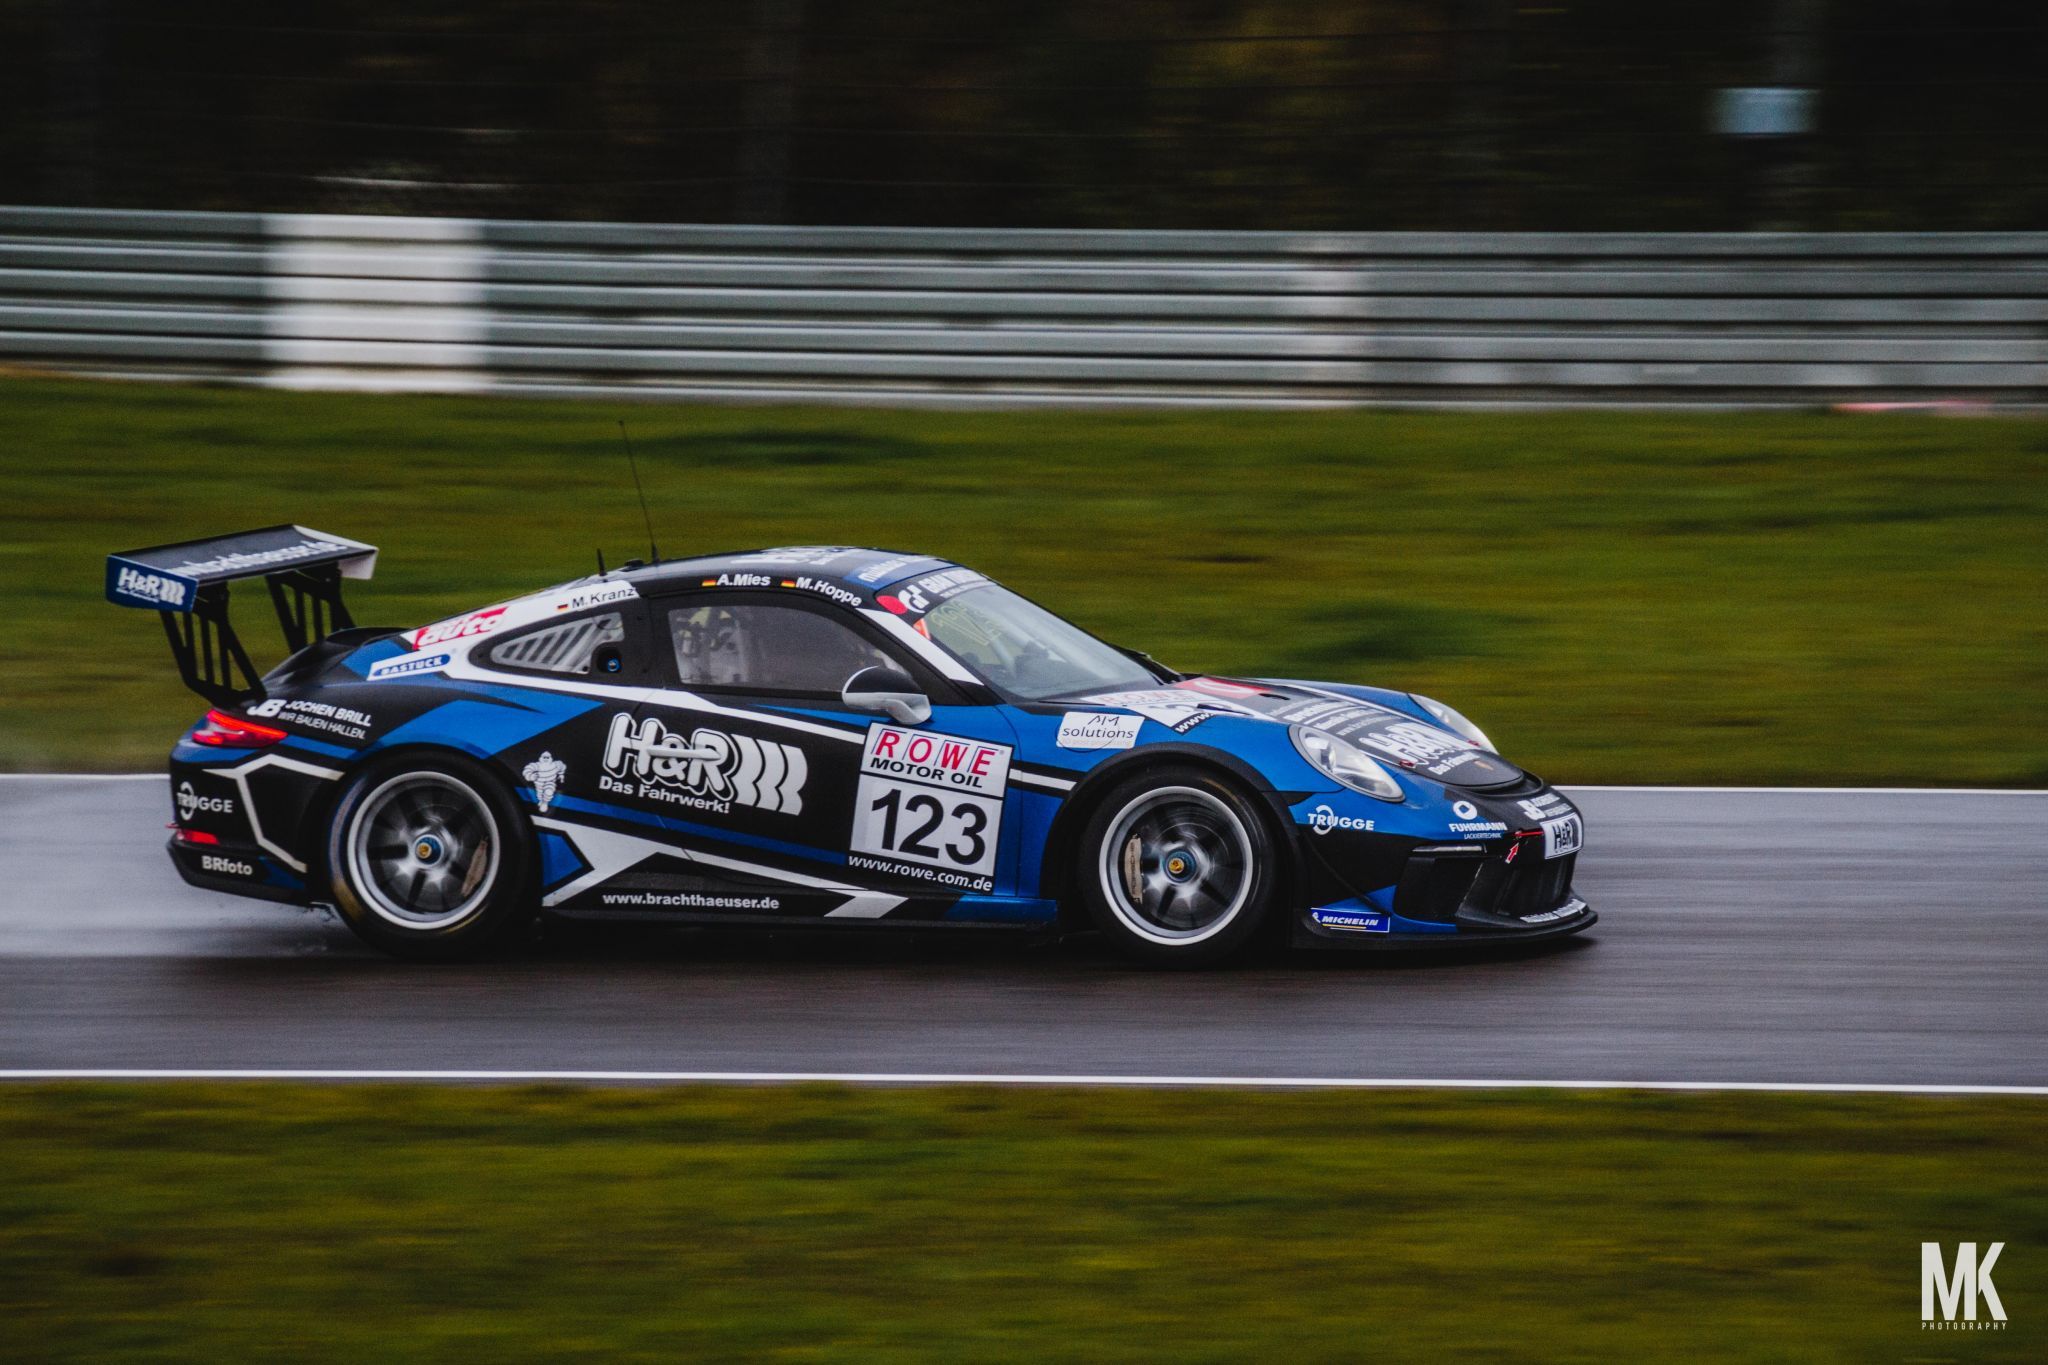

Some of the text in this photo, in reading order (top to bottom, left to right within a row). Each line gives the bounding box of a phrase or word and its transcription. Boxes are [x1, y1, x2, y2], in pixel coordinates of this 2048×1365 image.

[717, 573, 771, 587] A.Mies
[795, 577, 862, 607] M.Hoppe
[381, 656, 443, 675] BASTUCK
[285, 700, 371, 727] JOCHEN BRILL
[295, 714, 328, 730] BAUEN
[1062, 727, 1134, 739] solutions
[603, 712, 738, 800] H&R
[872, 729, 996, 776] ROWE
[870, 757, 983, 788] MOTOR OIL
[599, 775, 730, 813] Das Fahrwerk!
[871, 788, 988, 866] 123
[1307, 813, 1375, 831] TRUGGE
[1448, 821, 1508, 832] FUHRMANN
[202, 855, 253, 875] BRfoto
[848, 855, 993, 892] www.rowe.com.de
[603, 892, 779, 909] www.brachthaeuser.de
[1321, 915, 1379, 926] MICHELIN
